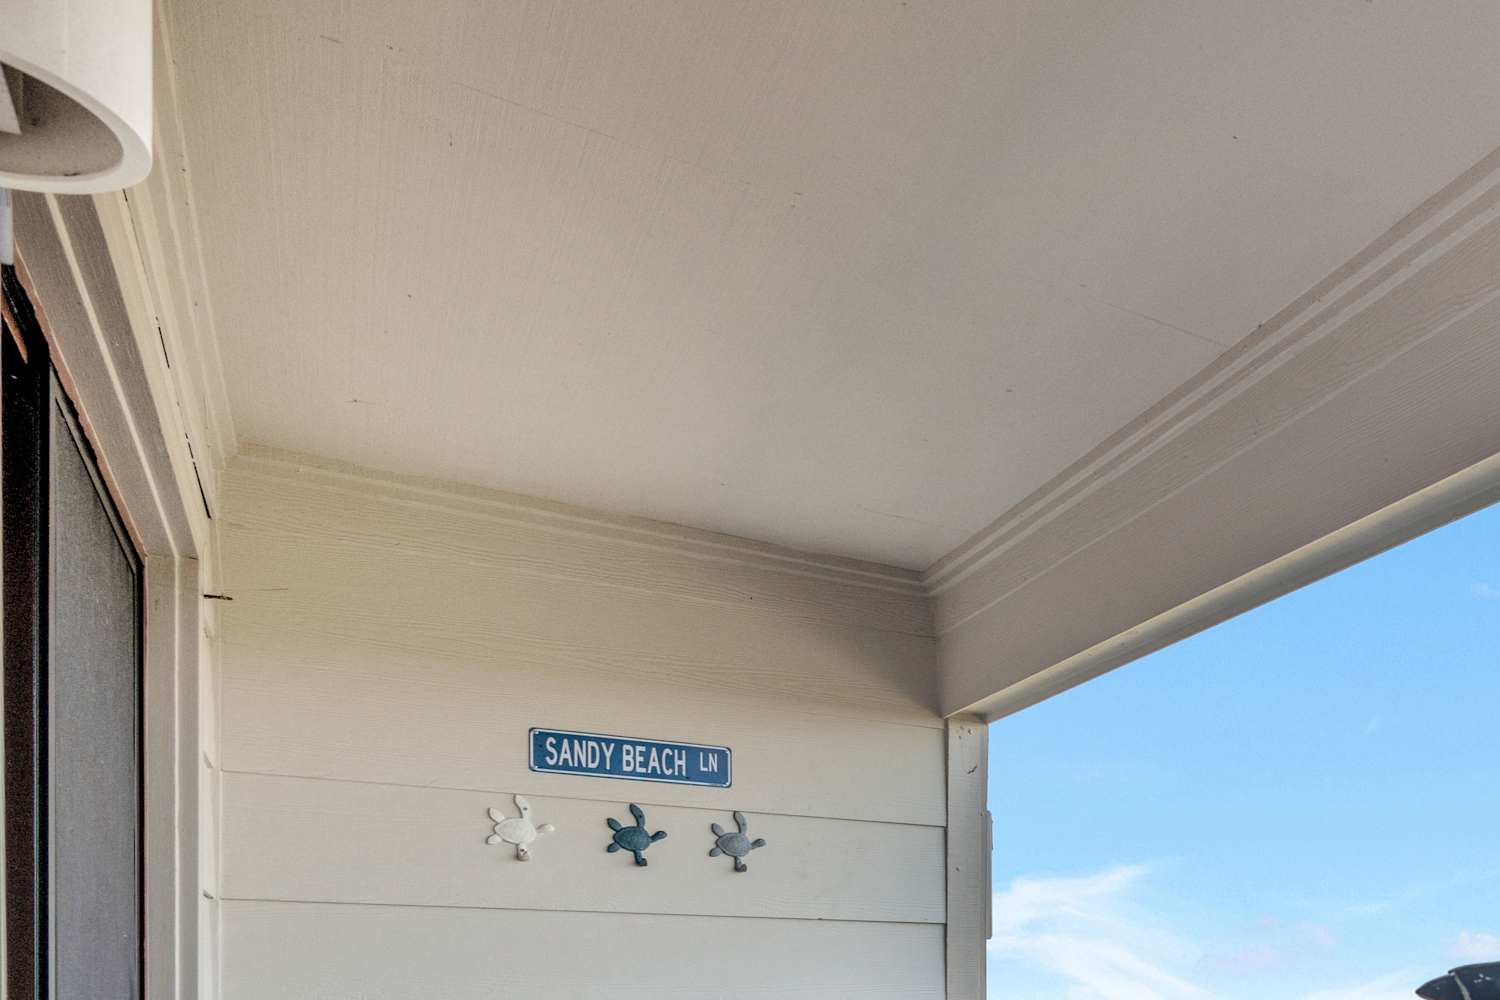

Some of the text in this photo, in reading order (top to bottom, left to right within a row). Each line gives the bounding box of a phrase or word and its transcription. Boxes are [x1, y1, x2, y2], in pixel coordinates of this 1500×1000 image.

[545, 736, 718, 776] SANDY BEACH LN
